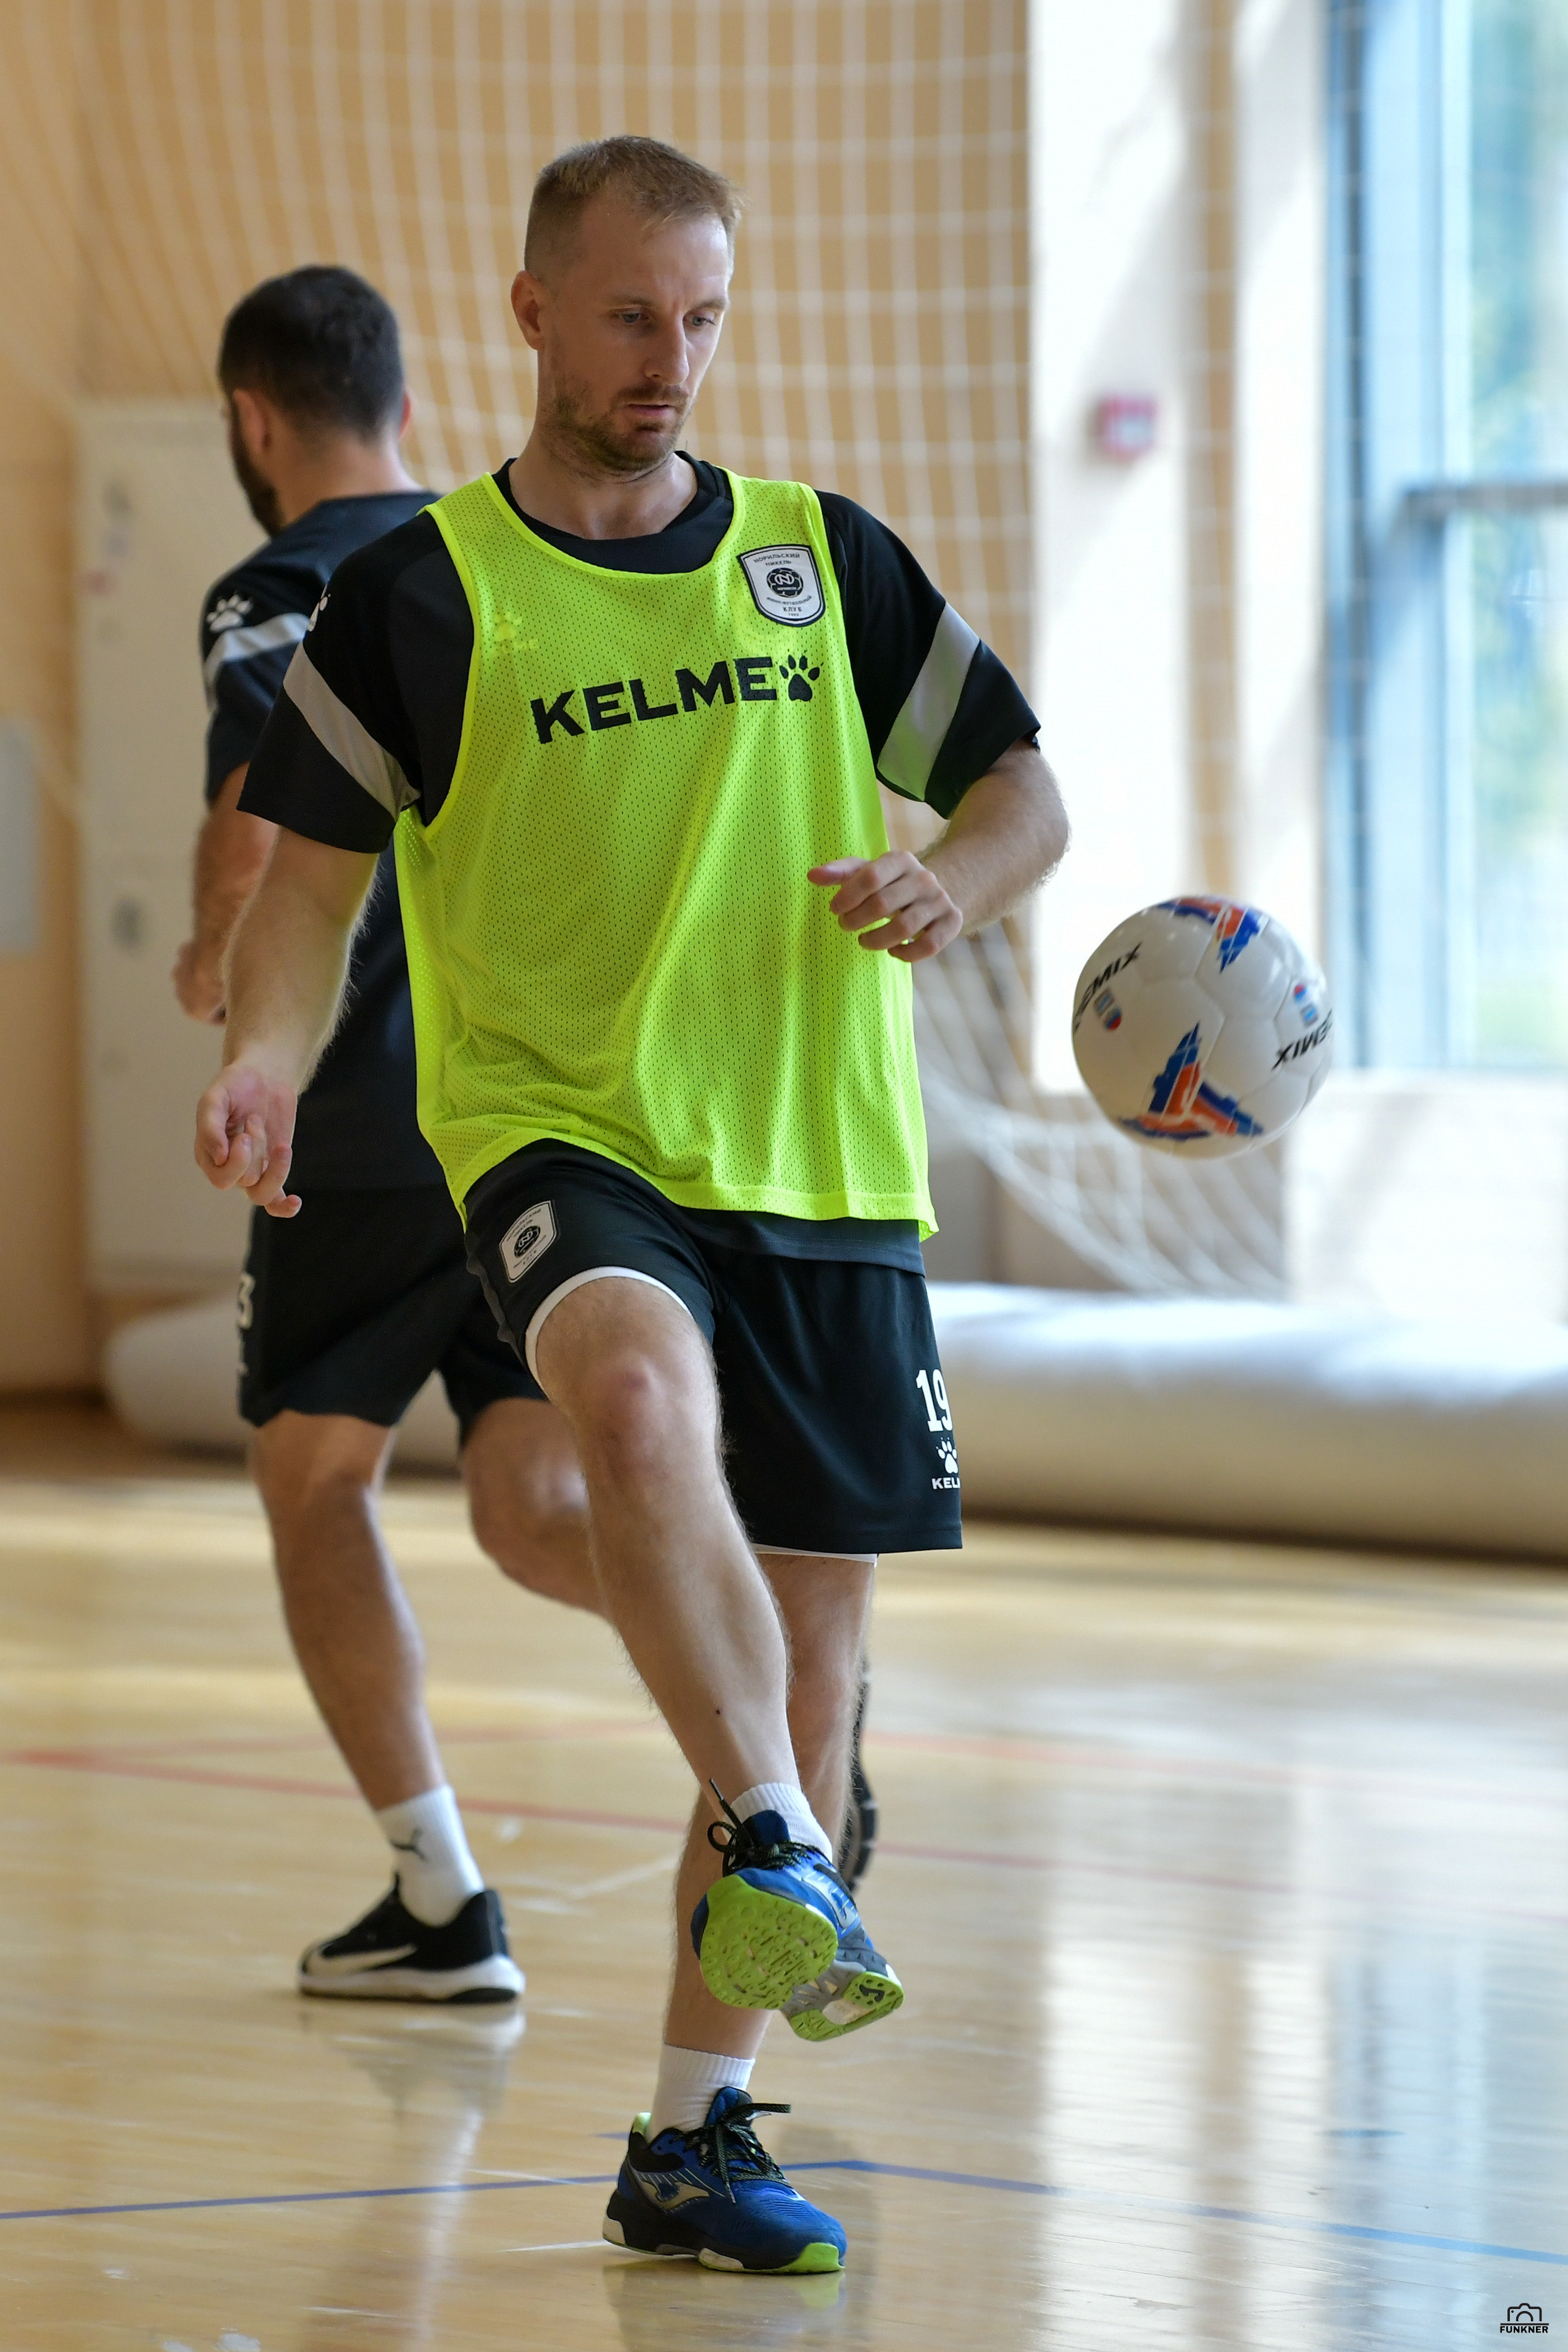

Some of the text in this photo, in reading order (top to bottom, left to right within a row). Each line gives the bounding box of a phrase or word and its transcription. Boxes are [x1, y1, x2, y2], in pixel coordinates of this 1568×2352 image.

[753, 553, 800, 563] НОРИЛЬСКИЙ
[530, 656, 778, 744] KELME
[916, 1368, 953, 1432] 19
[932, 1477, 961, 1490] KEL
